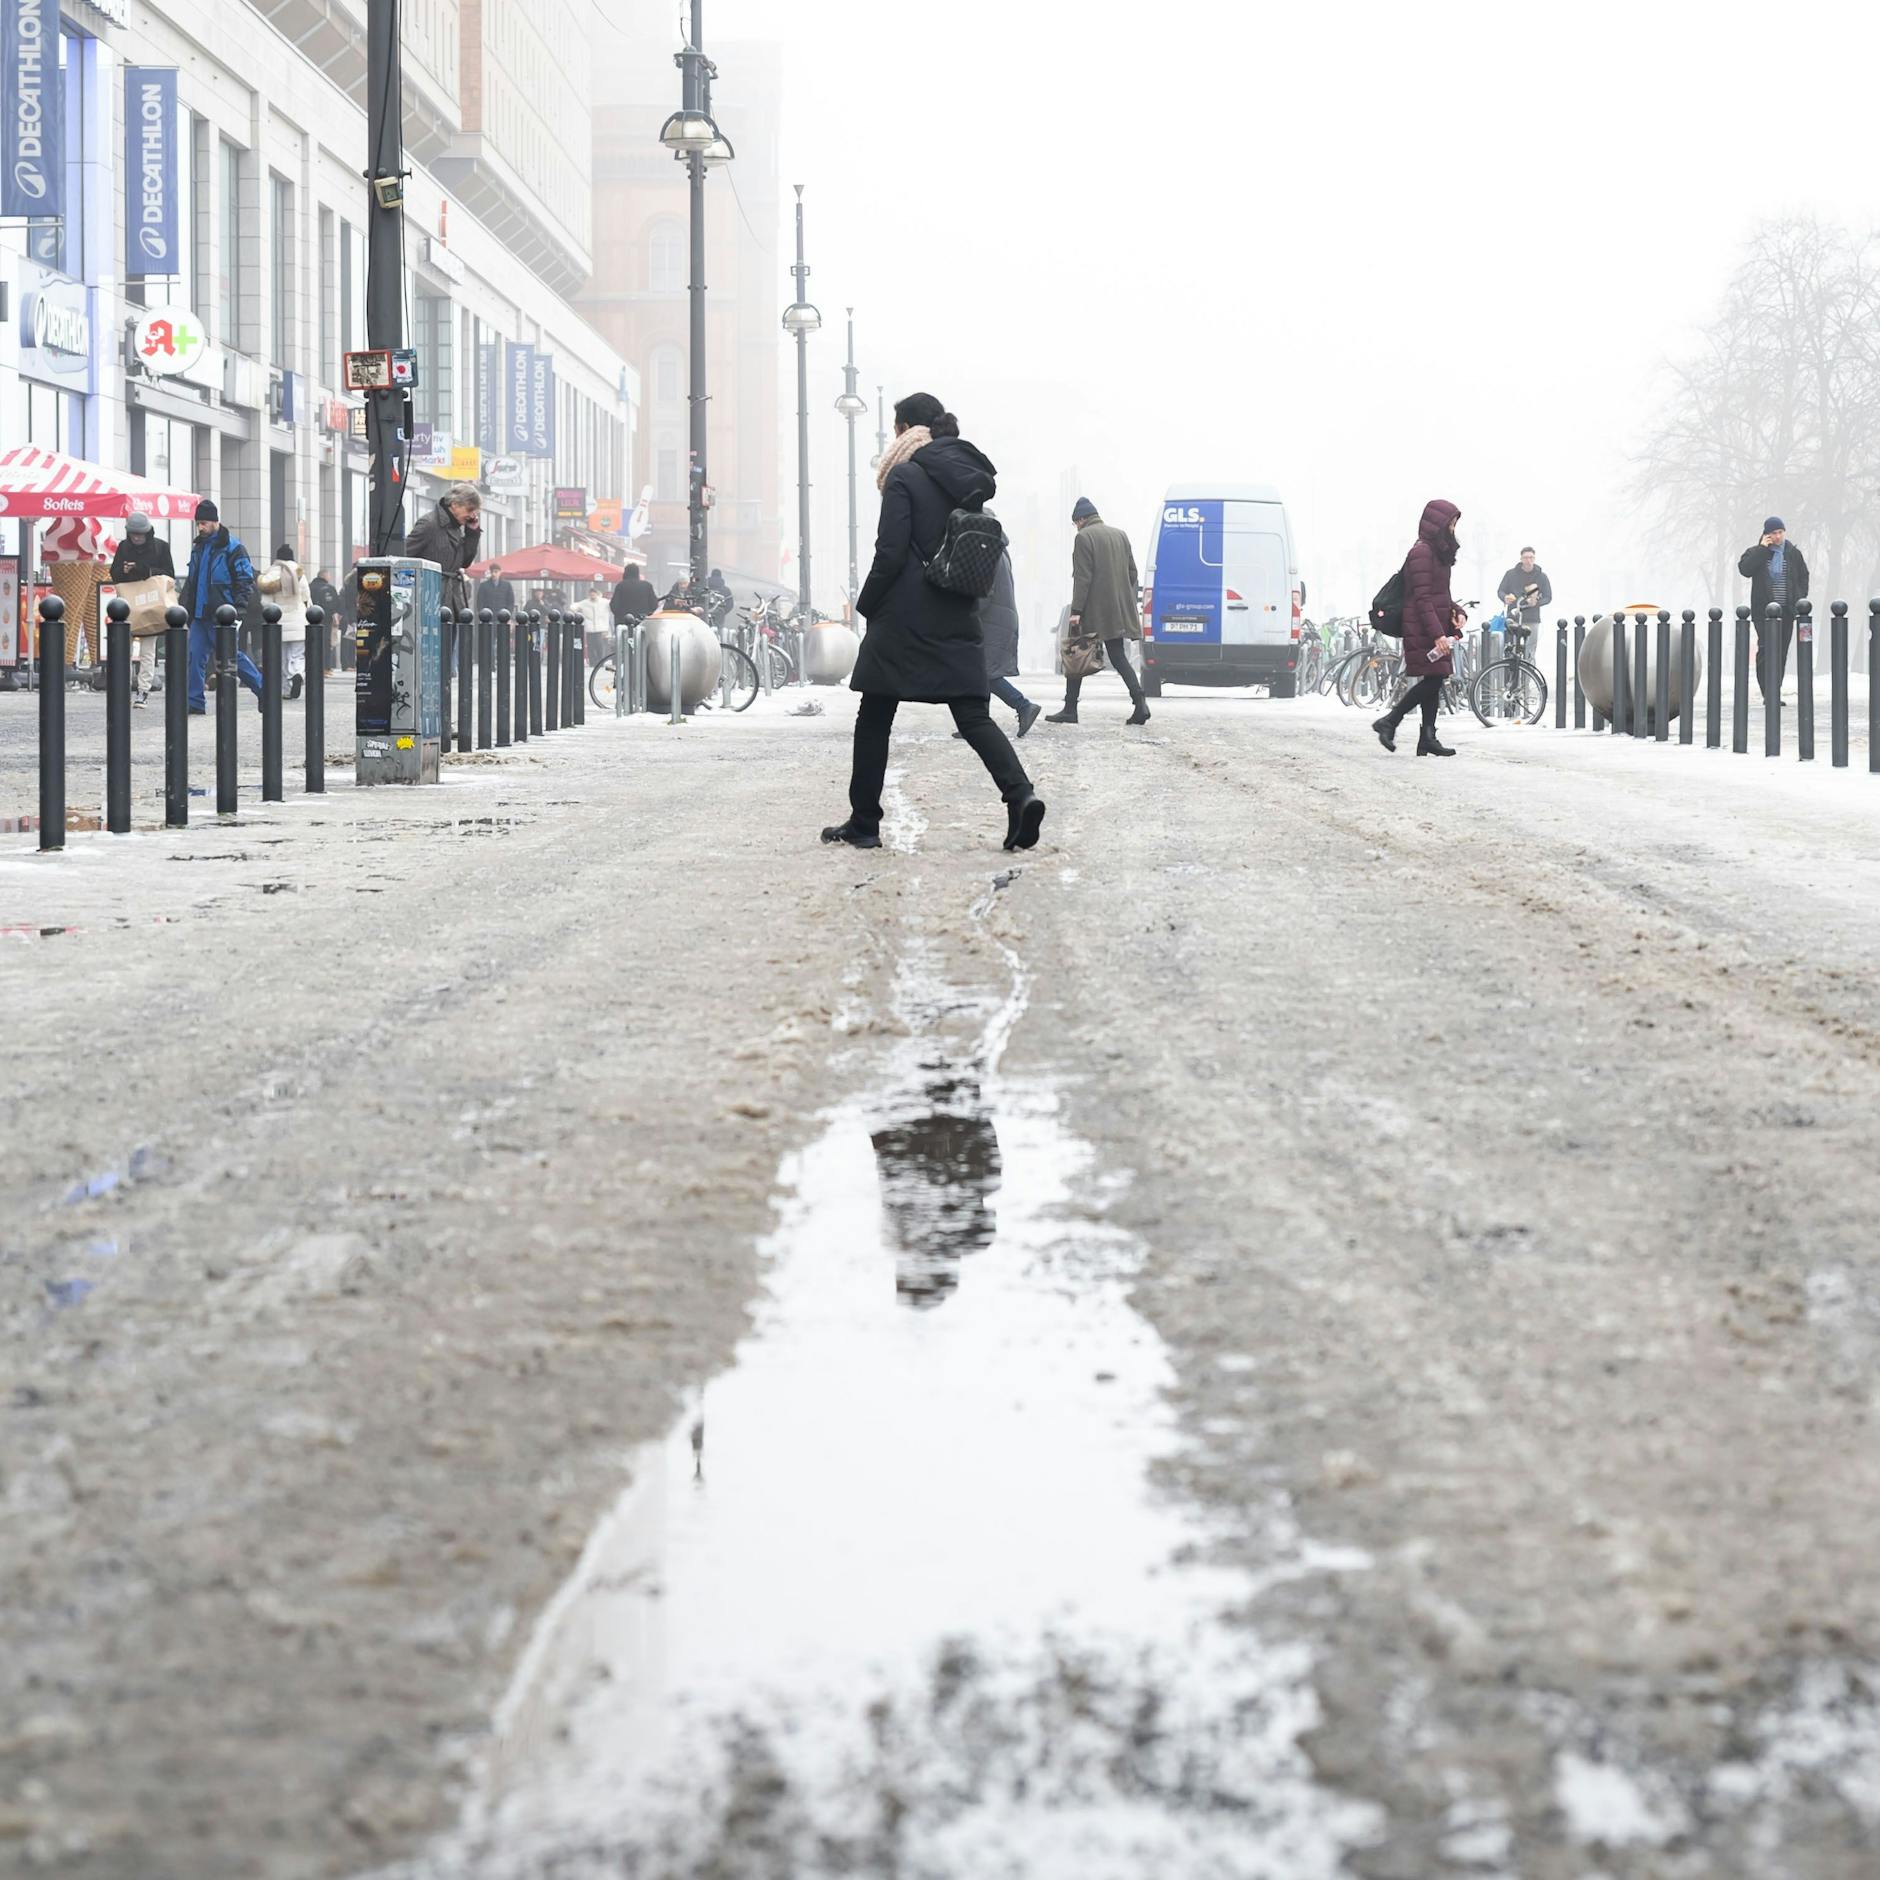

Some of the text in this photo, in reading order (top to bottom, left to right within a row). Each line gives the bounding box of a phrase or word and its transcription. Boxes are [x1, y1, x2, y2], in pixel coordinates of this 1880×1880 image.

[18, 0, 42, 158] DECATHLON
[141, 83, 163, 223] DECATHLON
[515, 350, 527, 423] DECATHLON
[534, 360, 545, 431] DECATHLON
